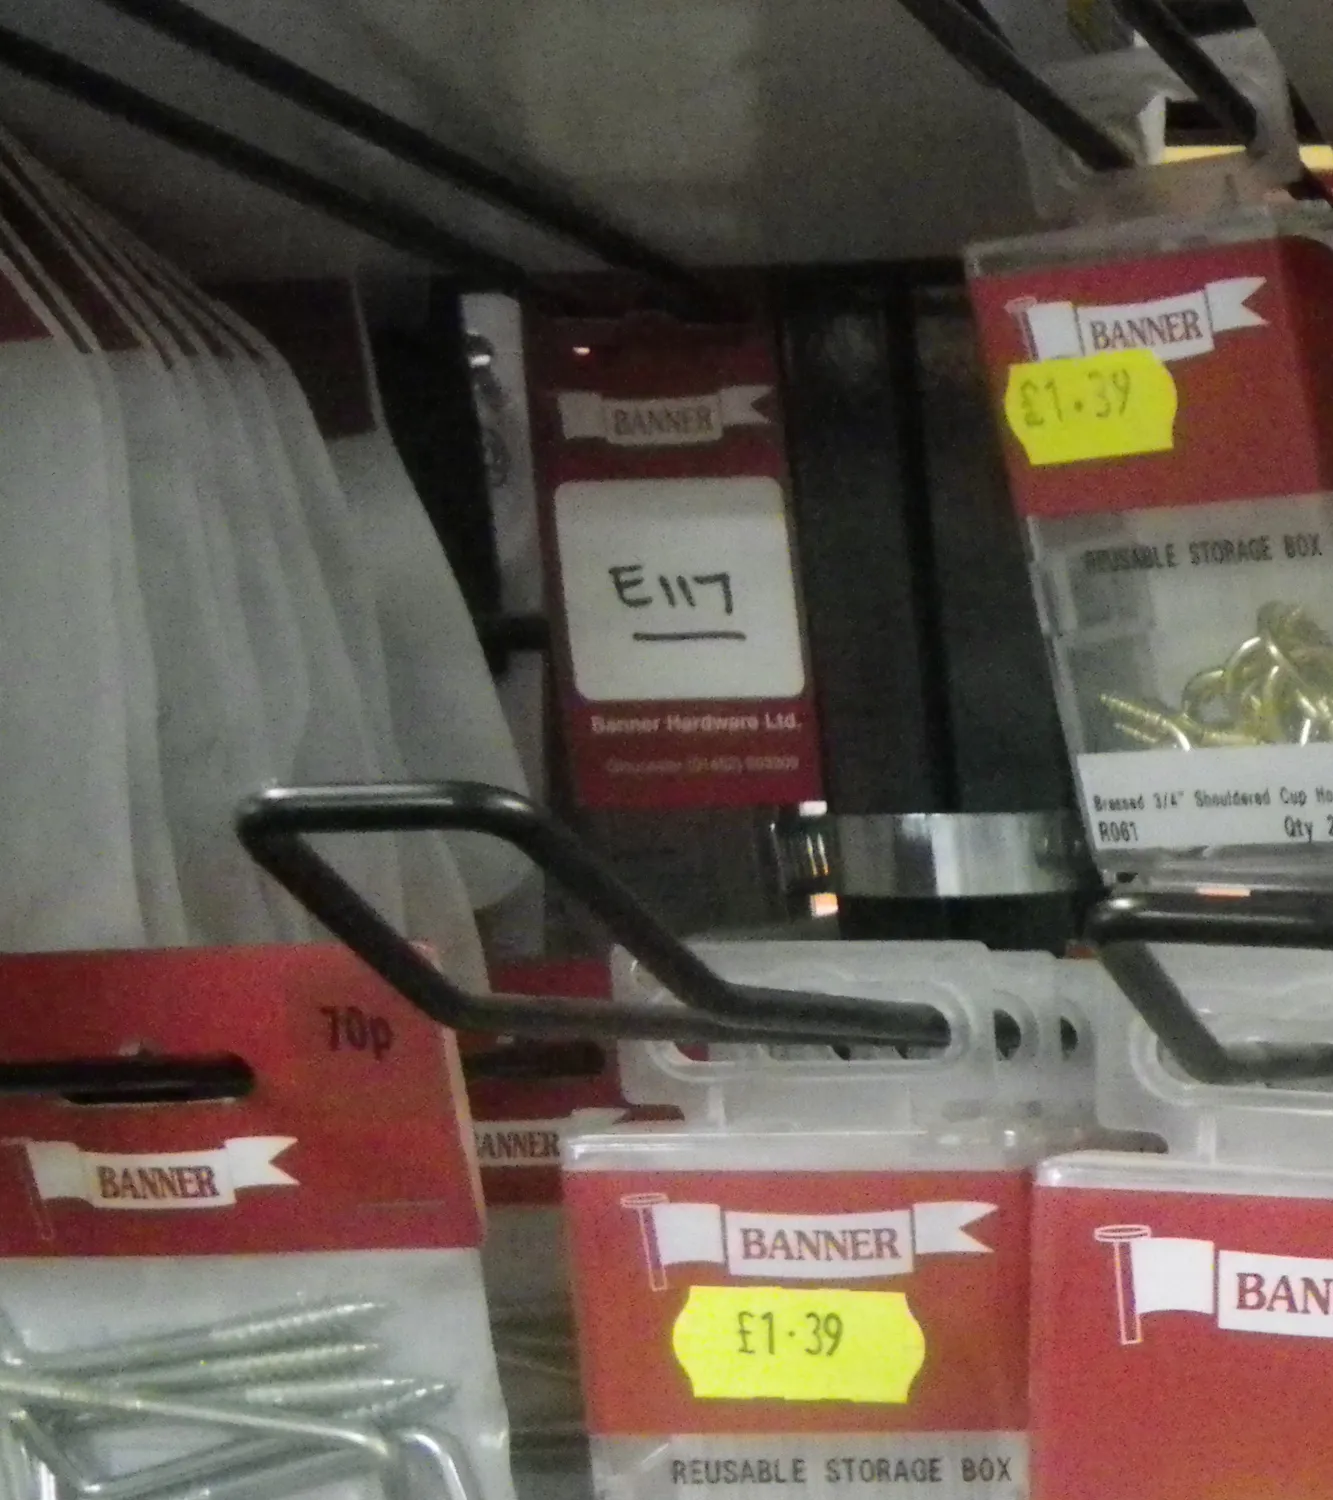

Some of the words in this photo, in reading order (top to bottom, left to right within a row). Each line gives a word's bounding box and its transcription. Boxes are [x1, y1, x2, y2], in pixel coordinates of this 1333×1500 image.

[1090, 309, 1204, 350] BANNER
[614, 407, 713, 437] BANNER
[1188, 535, 1272, 565] STORAGE
[1283, 533, 1322, 559] BOX
[1280, 787, 1307, 806] Cup
[1285, 816, 1313, 842] Qty
[97, 1165, 220, 1200] BANNER
[740, 1227, 902, 1261] BANNER
[671, 1458, 806, 1485] REUSABLE
[825, 1458, 943, 1484] STORAGE
[962, 1457, 1012, 1482] BOX
